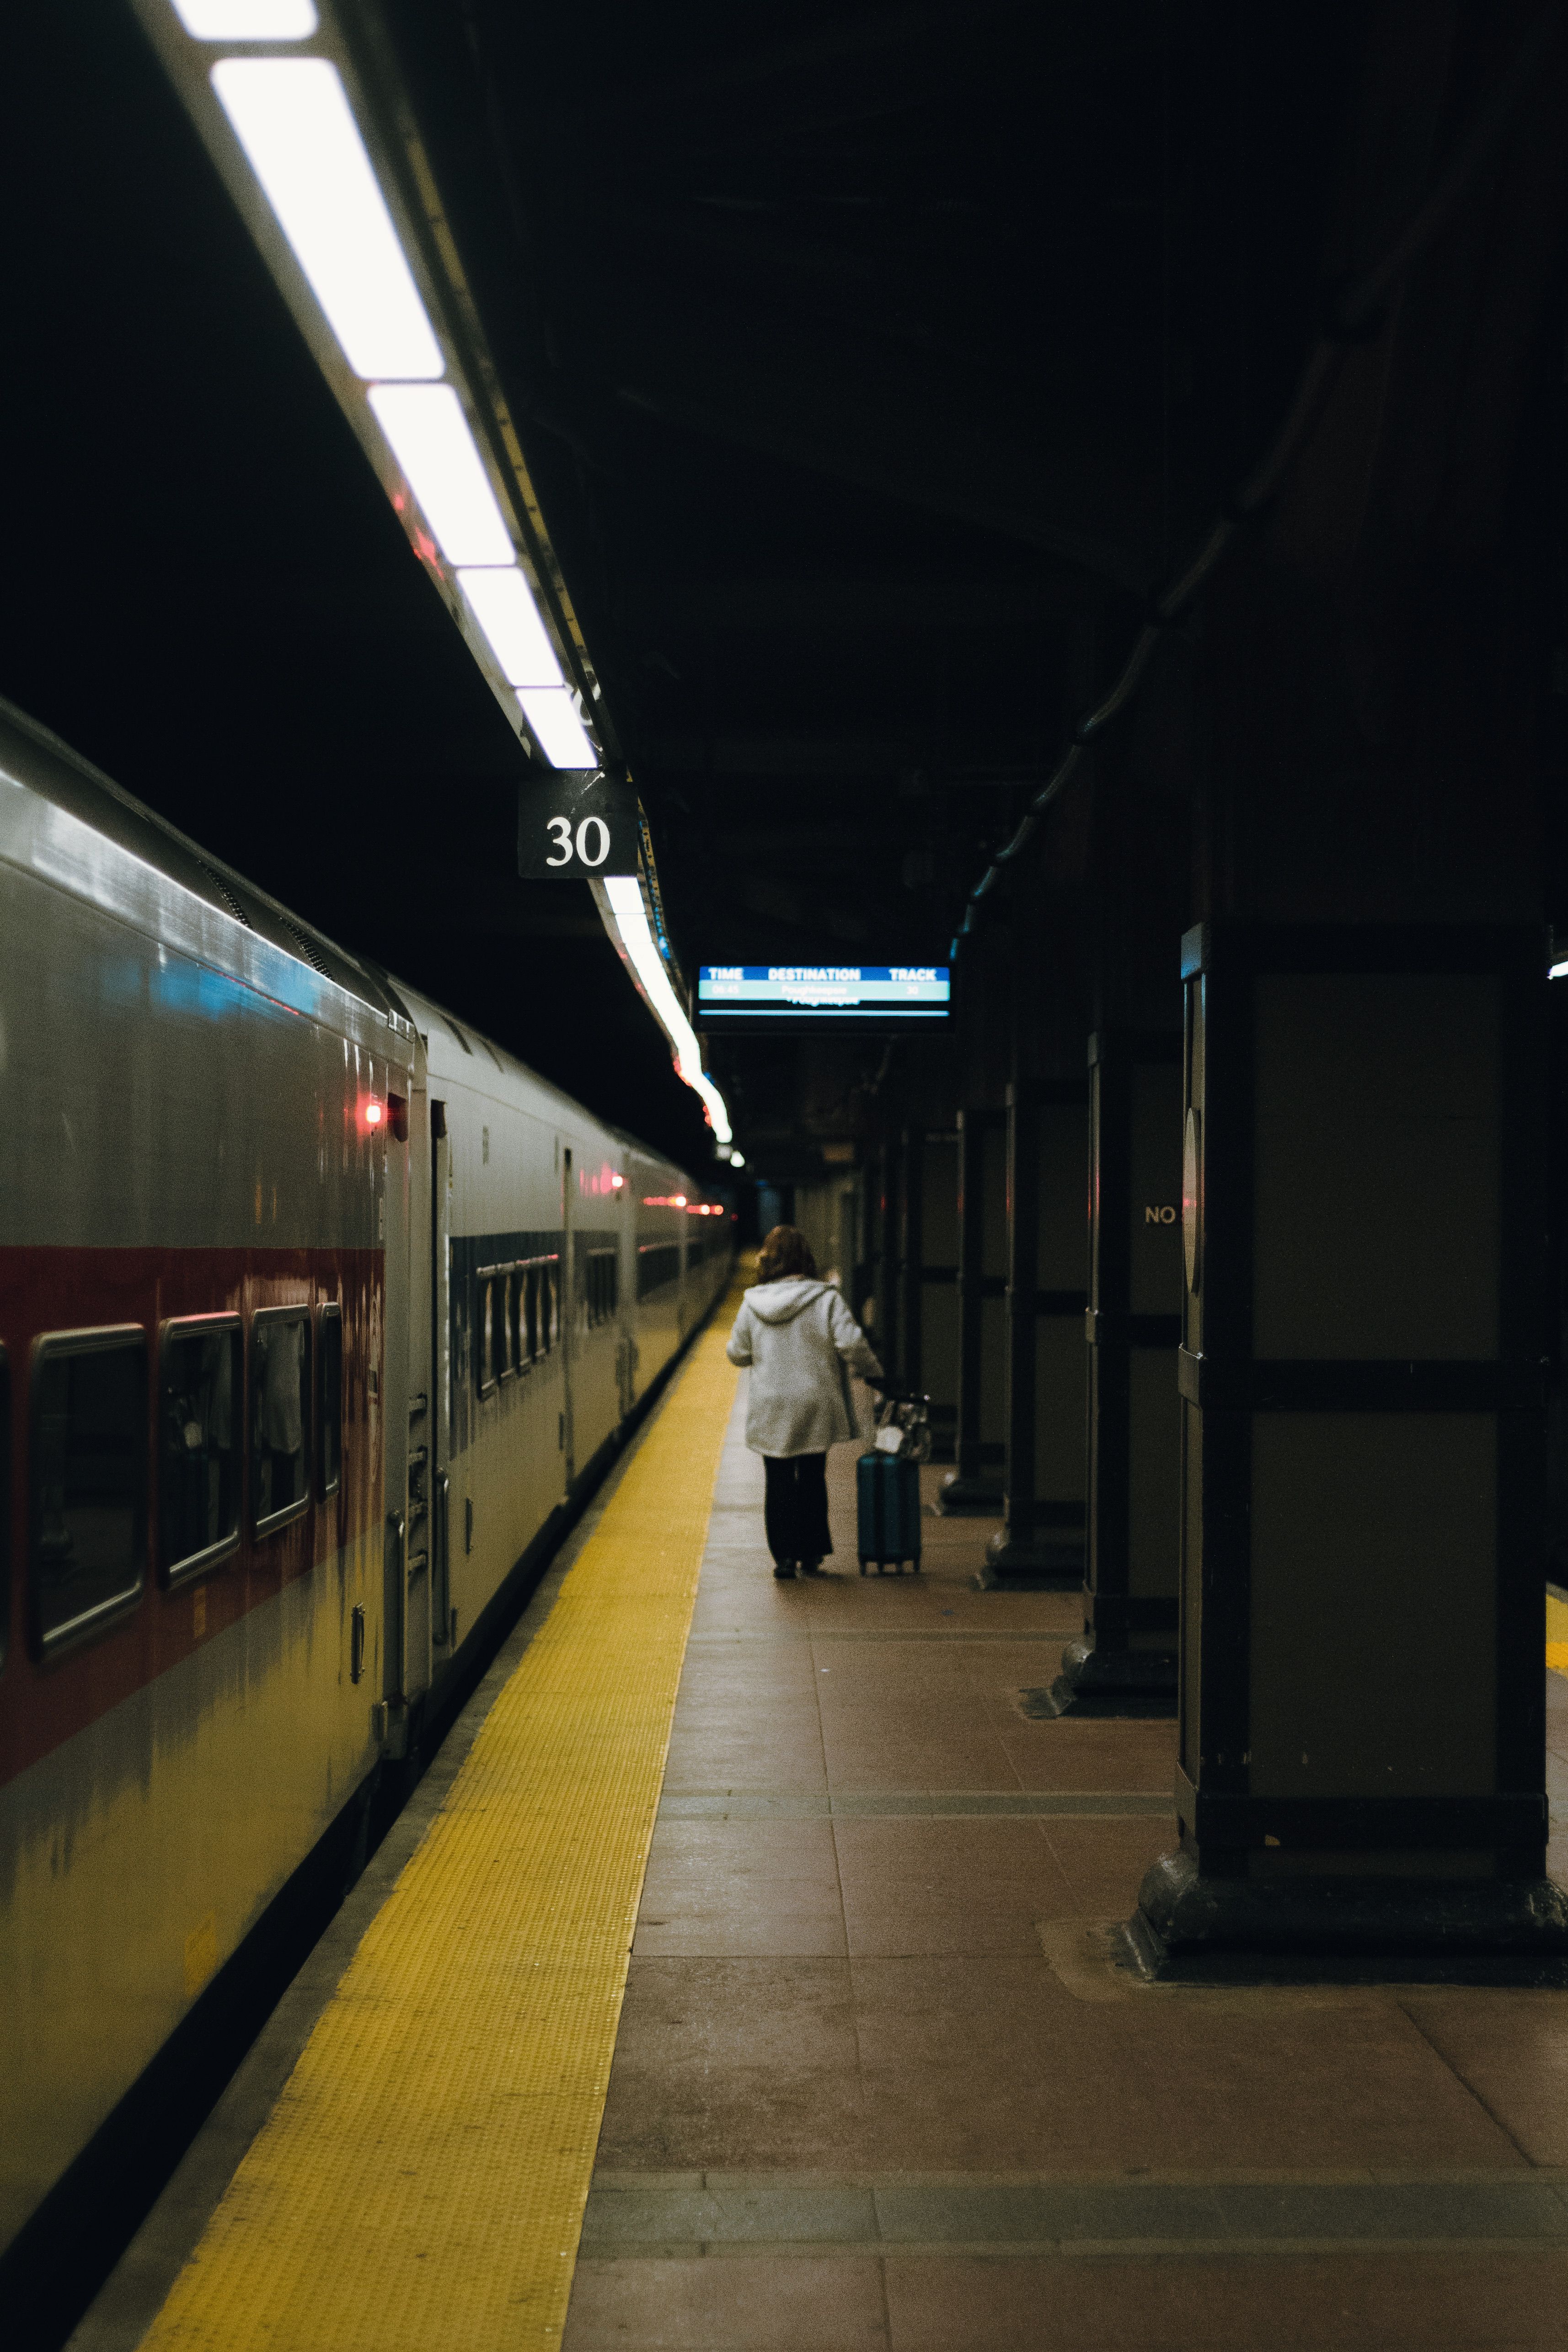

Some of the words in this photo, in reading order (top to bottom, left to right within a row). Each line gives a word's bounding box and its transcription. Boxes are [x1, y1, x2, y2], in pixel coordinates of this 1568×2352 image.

[546, 817, 610, 866] 30
[709, 967, 744, 980] TIME
[768, 968, 861, 981] DESTINATION
[888, 968, 937, 981] TRACK
[907, 985, 919, 994] 30
[1145, 1205, 1177, 1224] NO
